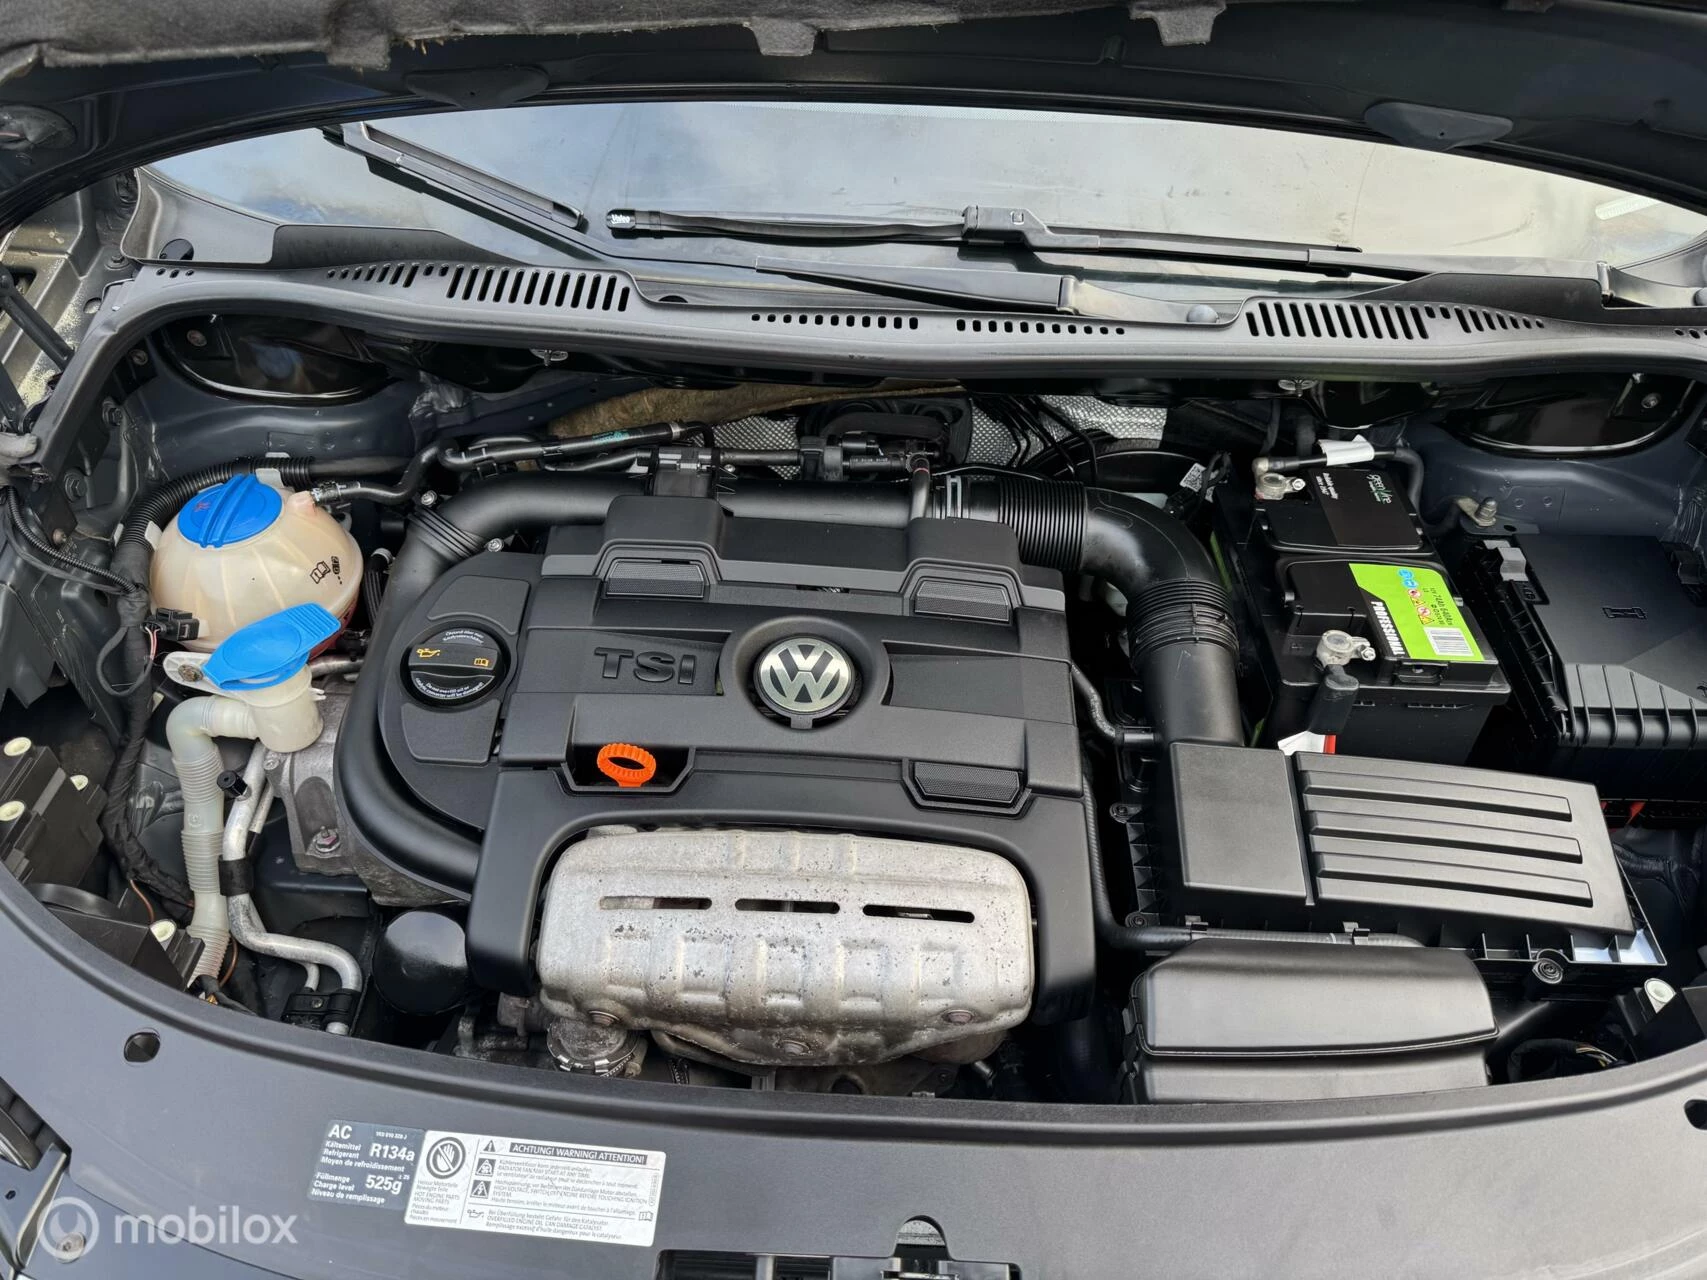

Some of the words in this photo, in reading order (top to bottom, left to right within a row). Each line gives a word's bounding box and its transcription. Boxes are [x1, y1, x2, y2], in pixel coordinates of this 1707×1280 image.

[1371, 601, 1405, 655] PROFESSIONAL
[594, 647, 697, 685] TSI
[328, 1124, 352, 1139] AC
[325, 1141, 361, 1150] Kältemittel
[370, 1143, 416, 1160] R134a
[323, 1149, 359, 1159] Refrigerant
[512, 1144, 554, 1154] ACHTUNG!
[556, 1148, 597, 1158] WARNING!
[598, 1151, 644, 1163] ATTENTION!
[321, 1157, 343, 1165] Moyen
[354, 1160, 404, 1172] refroidissement
[316, 1172, 350, 1183] Füllmenge
[364, 1175, 402, 1194] 525g
[313, 1181, 337, 1190] Charge
[338, 1184, 354, 1192] level
[311, 1189, 334, 1198] Niveau
[346, 1193, 384, 1204] remplissage
